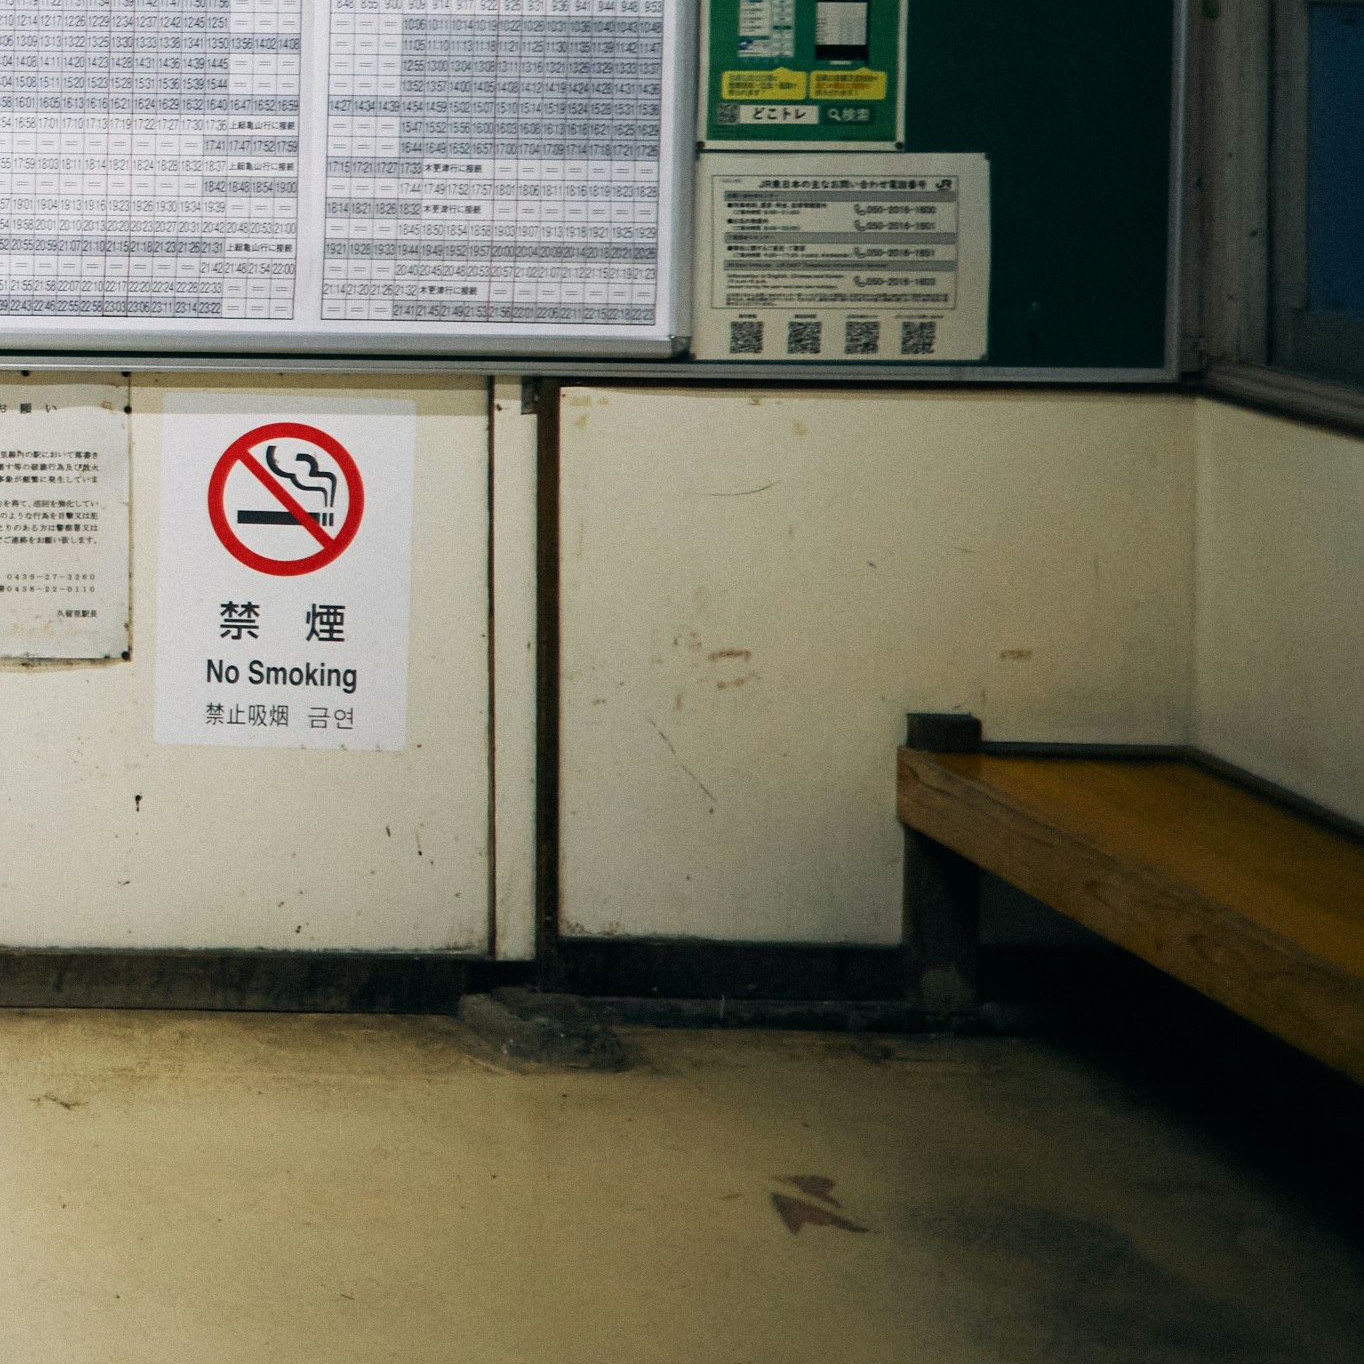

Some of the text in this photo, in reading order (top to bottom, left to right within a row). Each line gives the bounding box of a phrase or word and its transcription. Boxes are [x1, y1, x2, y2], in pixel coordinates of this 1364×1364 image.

[752, 108, 871, 122] どこトレ 検索
[206, 659, 358, 694] No Smoking
[204, 702, 290, 728] 禁止吸烟
[307, 706, 355, 731] 금연
